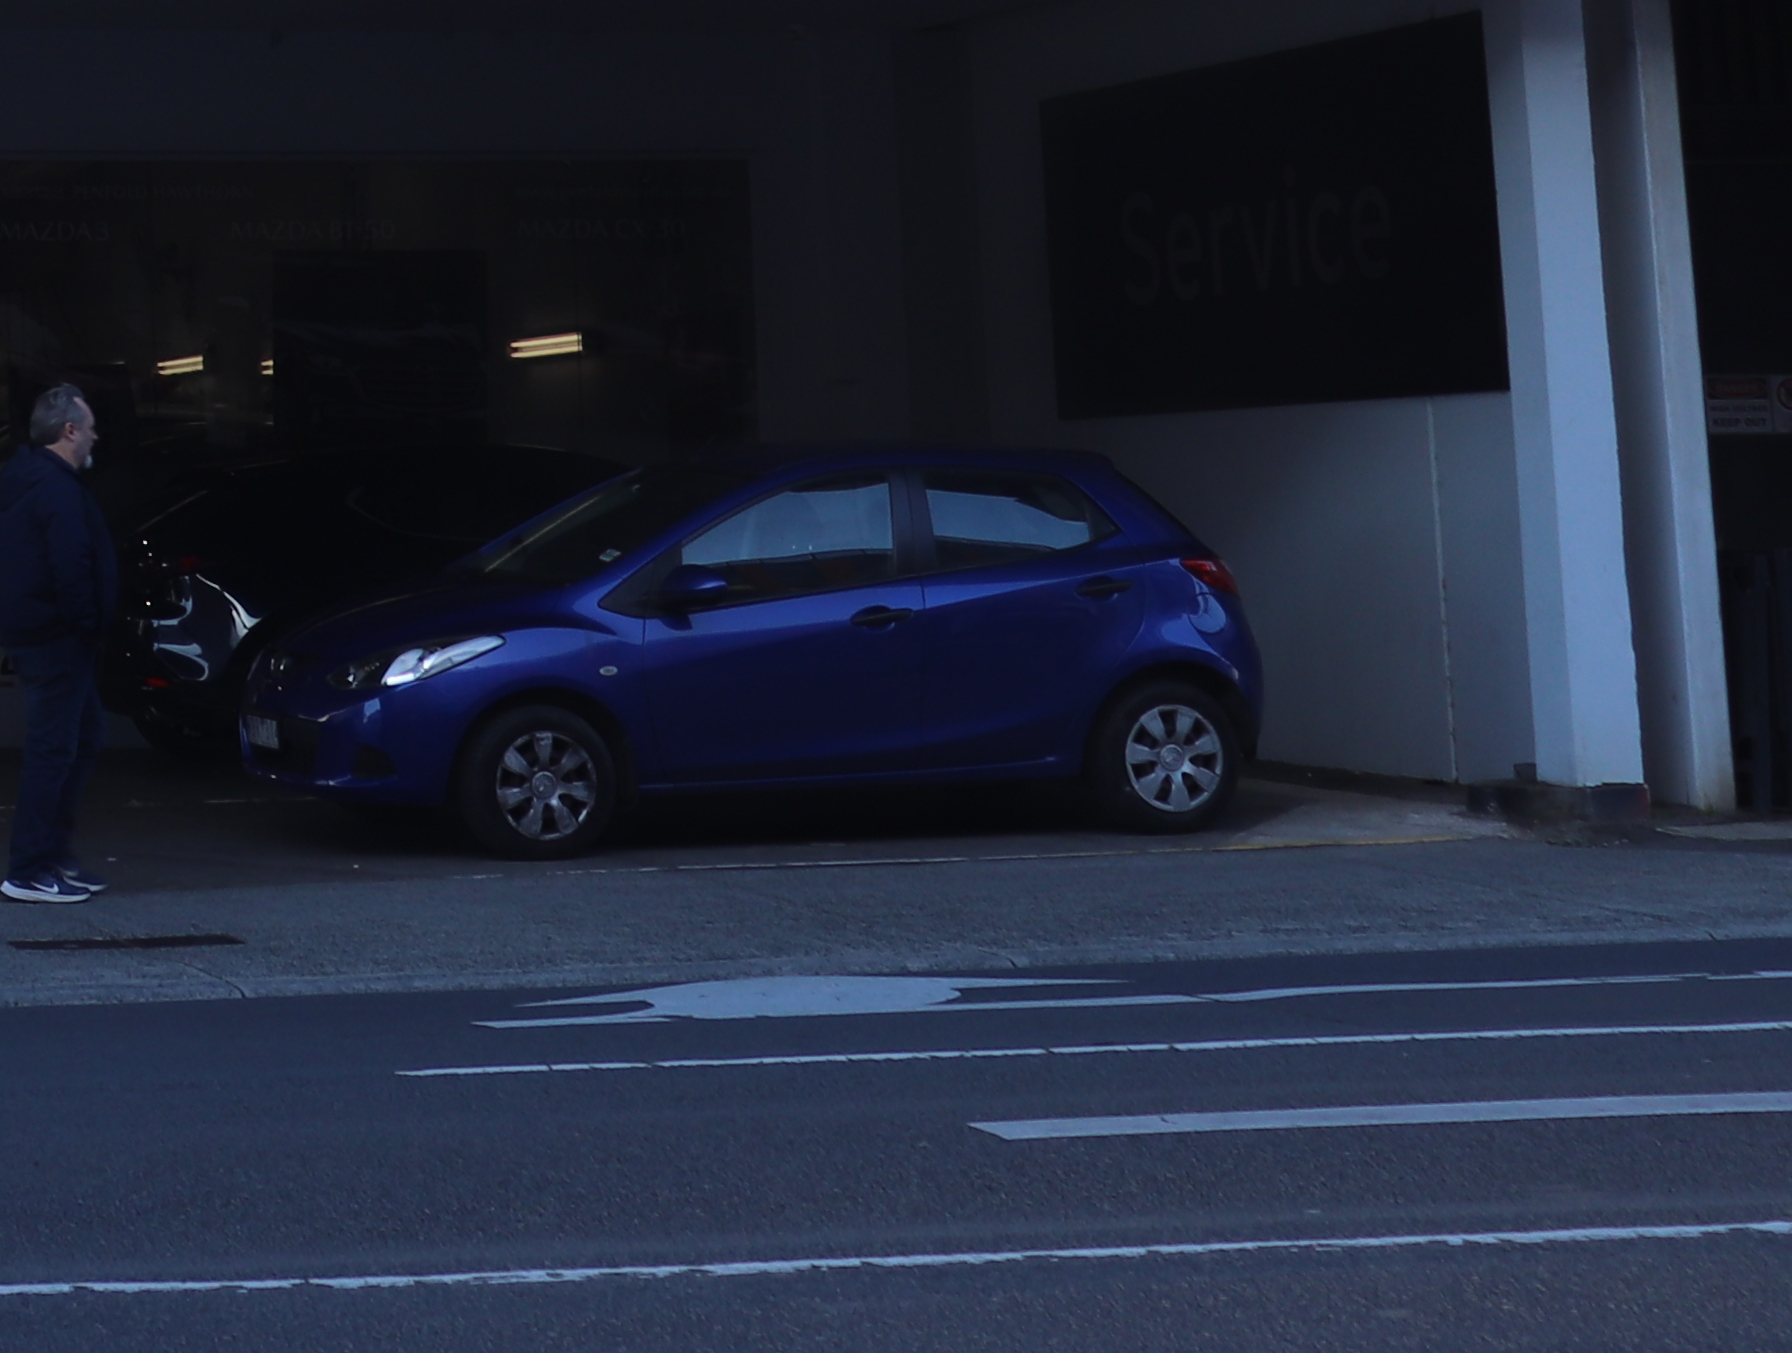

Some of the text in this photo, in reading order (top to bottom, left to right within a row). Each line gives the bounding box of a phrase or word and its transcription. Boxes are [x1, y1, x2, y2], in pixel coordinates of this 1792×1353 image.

[73, 185, 148, 199] PENFOLD
[153, 185, 254, 200] HAWTHORN
[230, 219, 396, 240] MAZDA BT-50
[518, 219, 609, 239] MAZDA
[1120, 163, 1393, 305] Service
